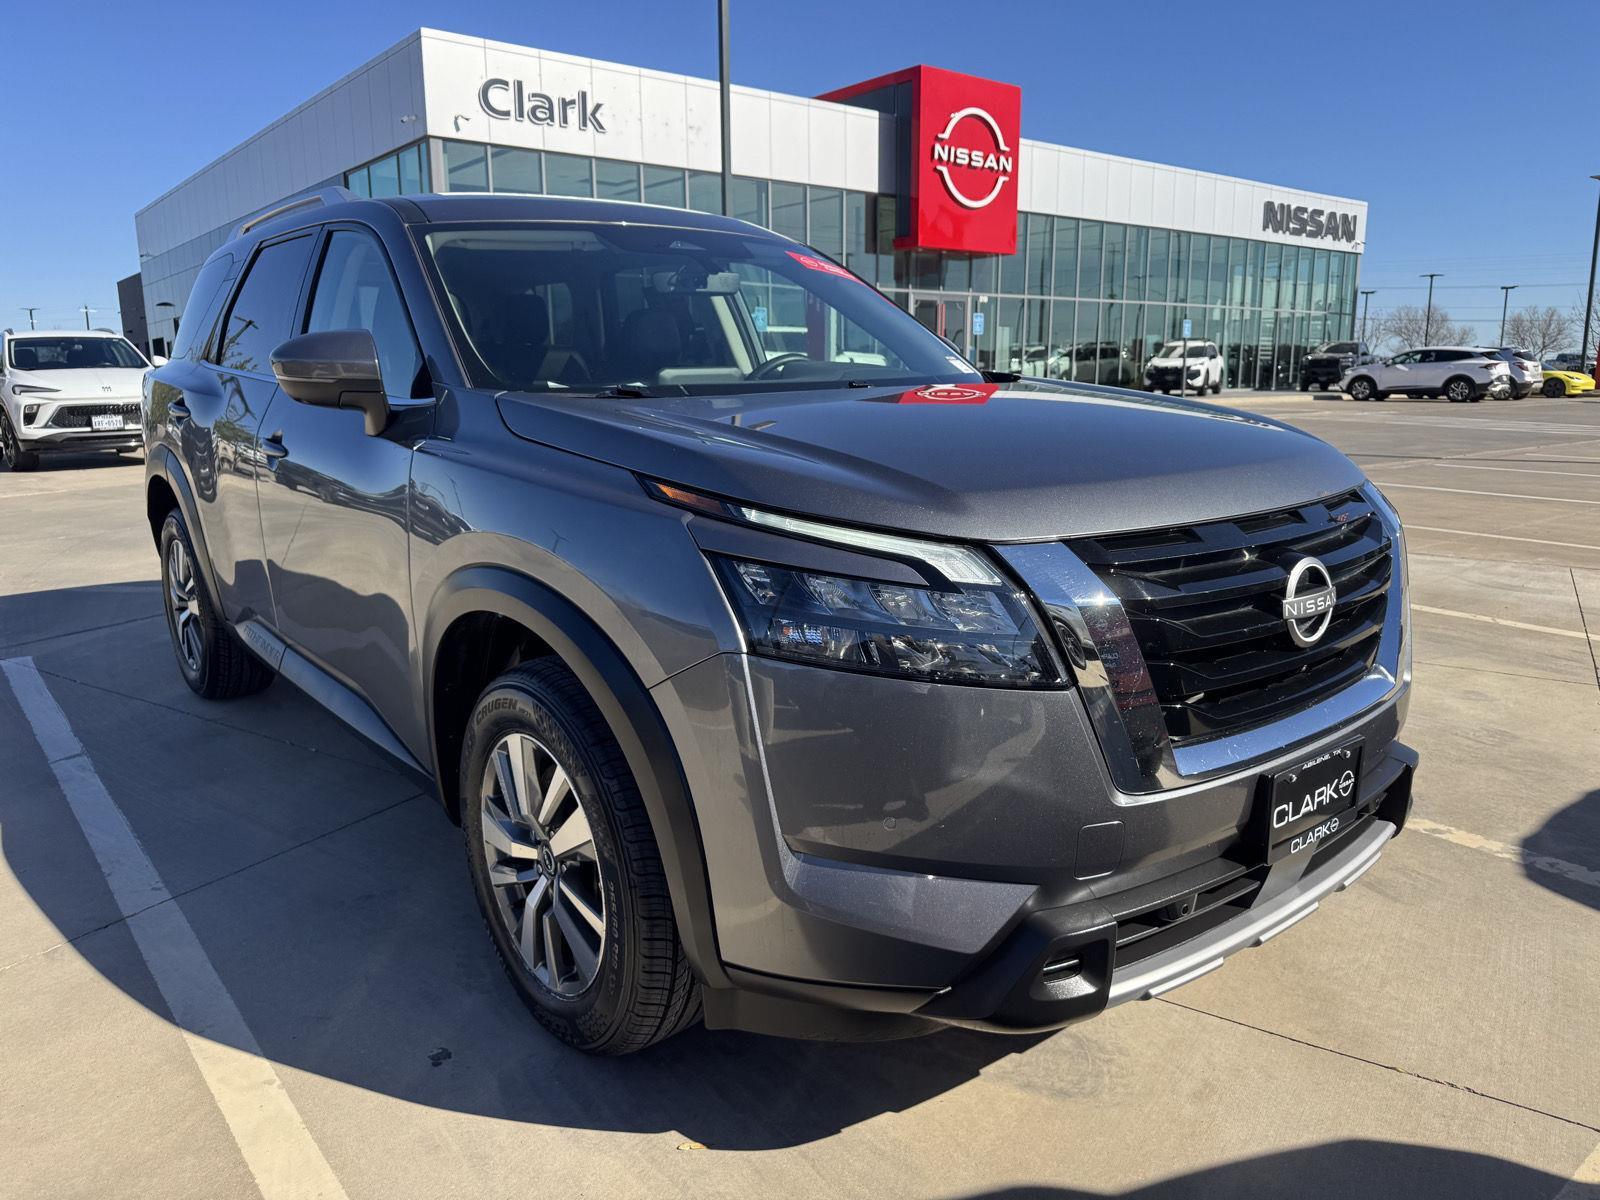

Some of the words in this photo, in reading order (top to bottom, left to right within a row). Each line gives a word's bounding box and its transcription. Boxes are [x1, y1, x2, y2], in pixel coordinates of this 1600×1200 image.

[478, 78, 606, 133] Clark
[933, 142, 1013, 173] NISSAN
[1262, 200, 1358, 243] NISSAN
[1285, 591, 1336, 617] NISSAN
[475, 697, 518, 727] CRUGEN
[1273, 778, 1338, 829] CLARK
[1290, 821, 1331, 854] CLARK
